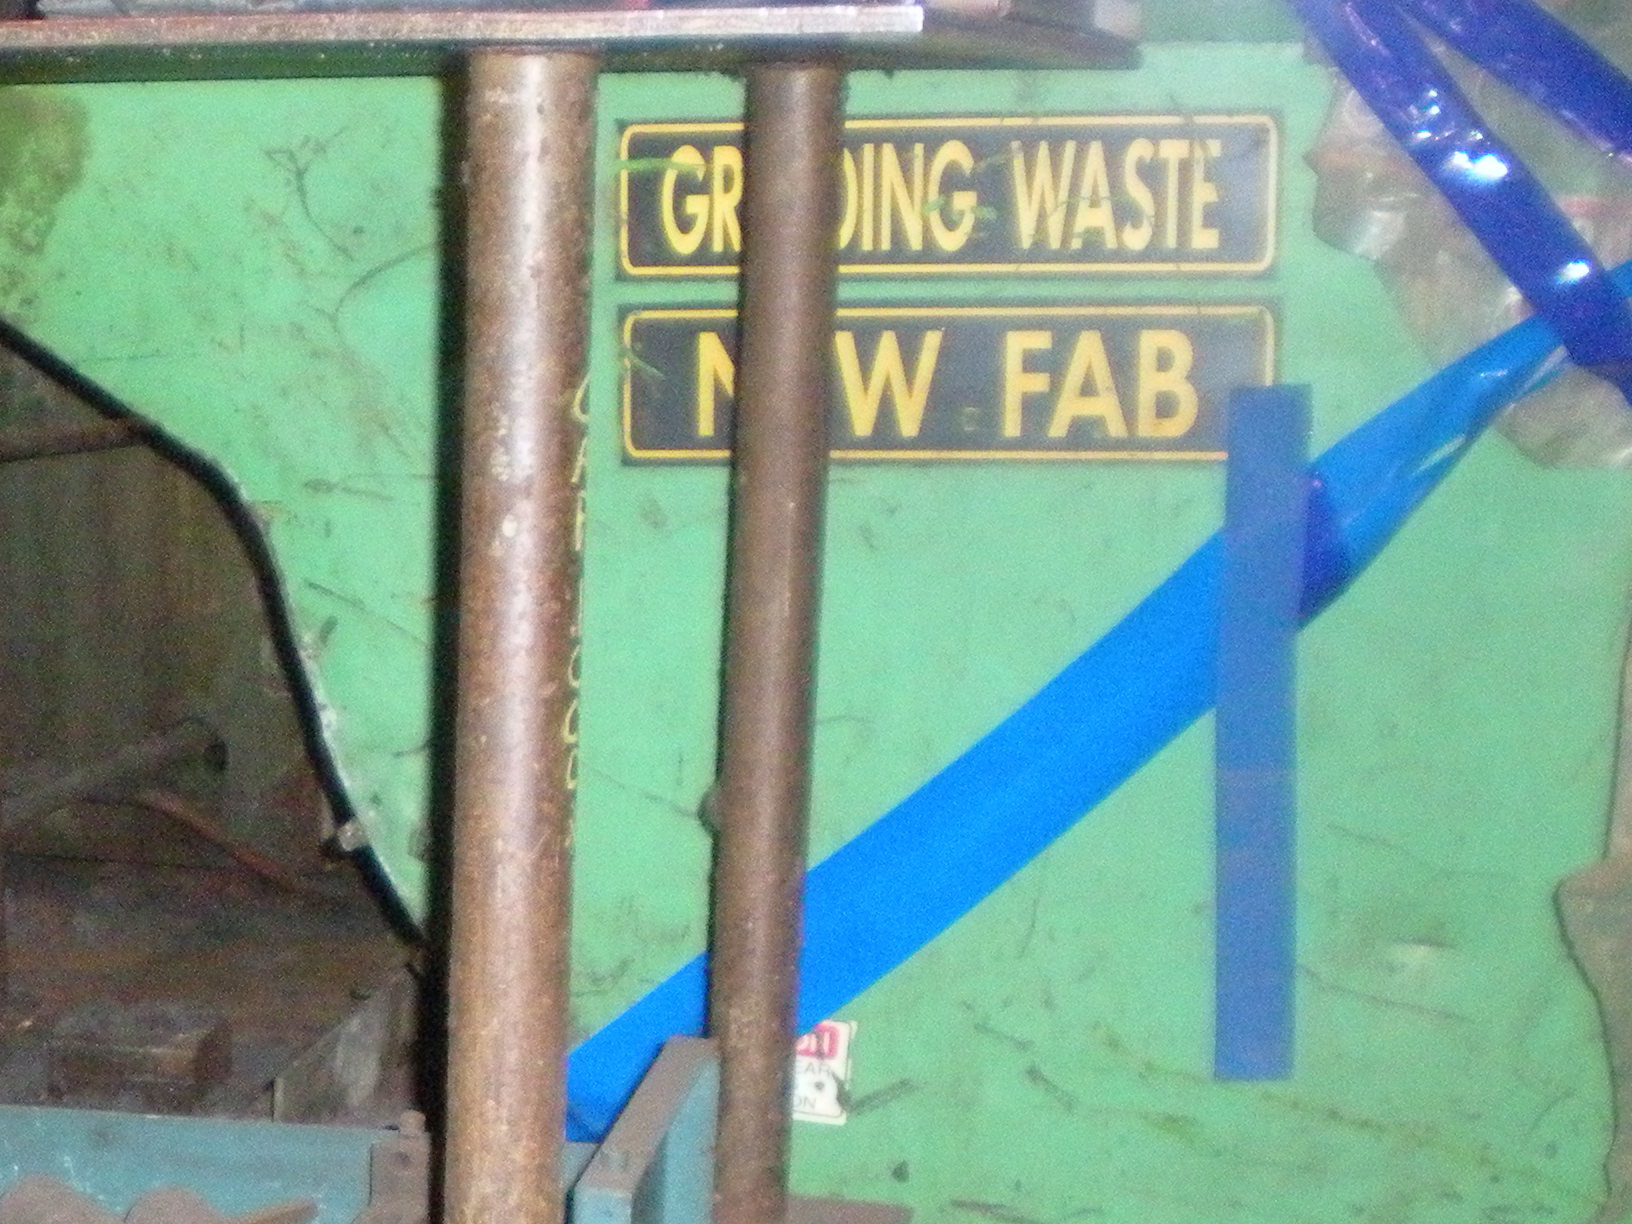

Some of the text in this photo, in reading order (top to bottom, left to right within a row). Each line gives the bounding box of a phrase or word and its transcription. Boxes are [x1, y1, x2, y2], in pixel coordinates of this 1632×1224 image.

[662, 137, 1222, 254] GRDING WASTE
[696, 328, 1200, 438] NW FAB
